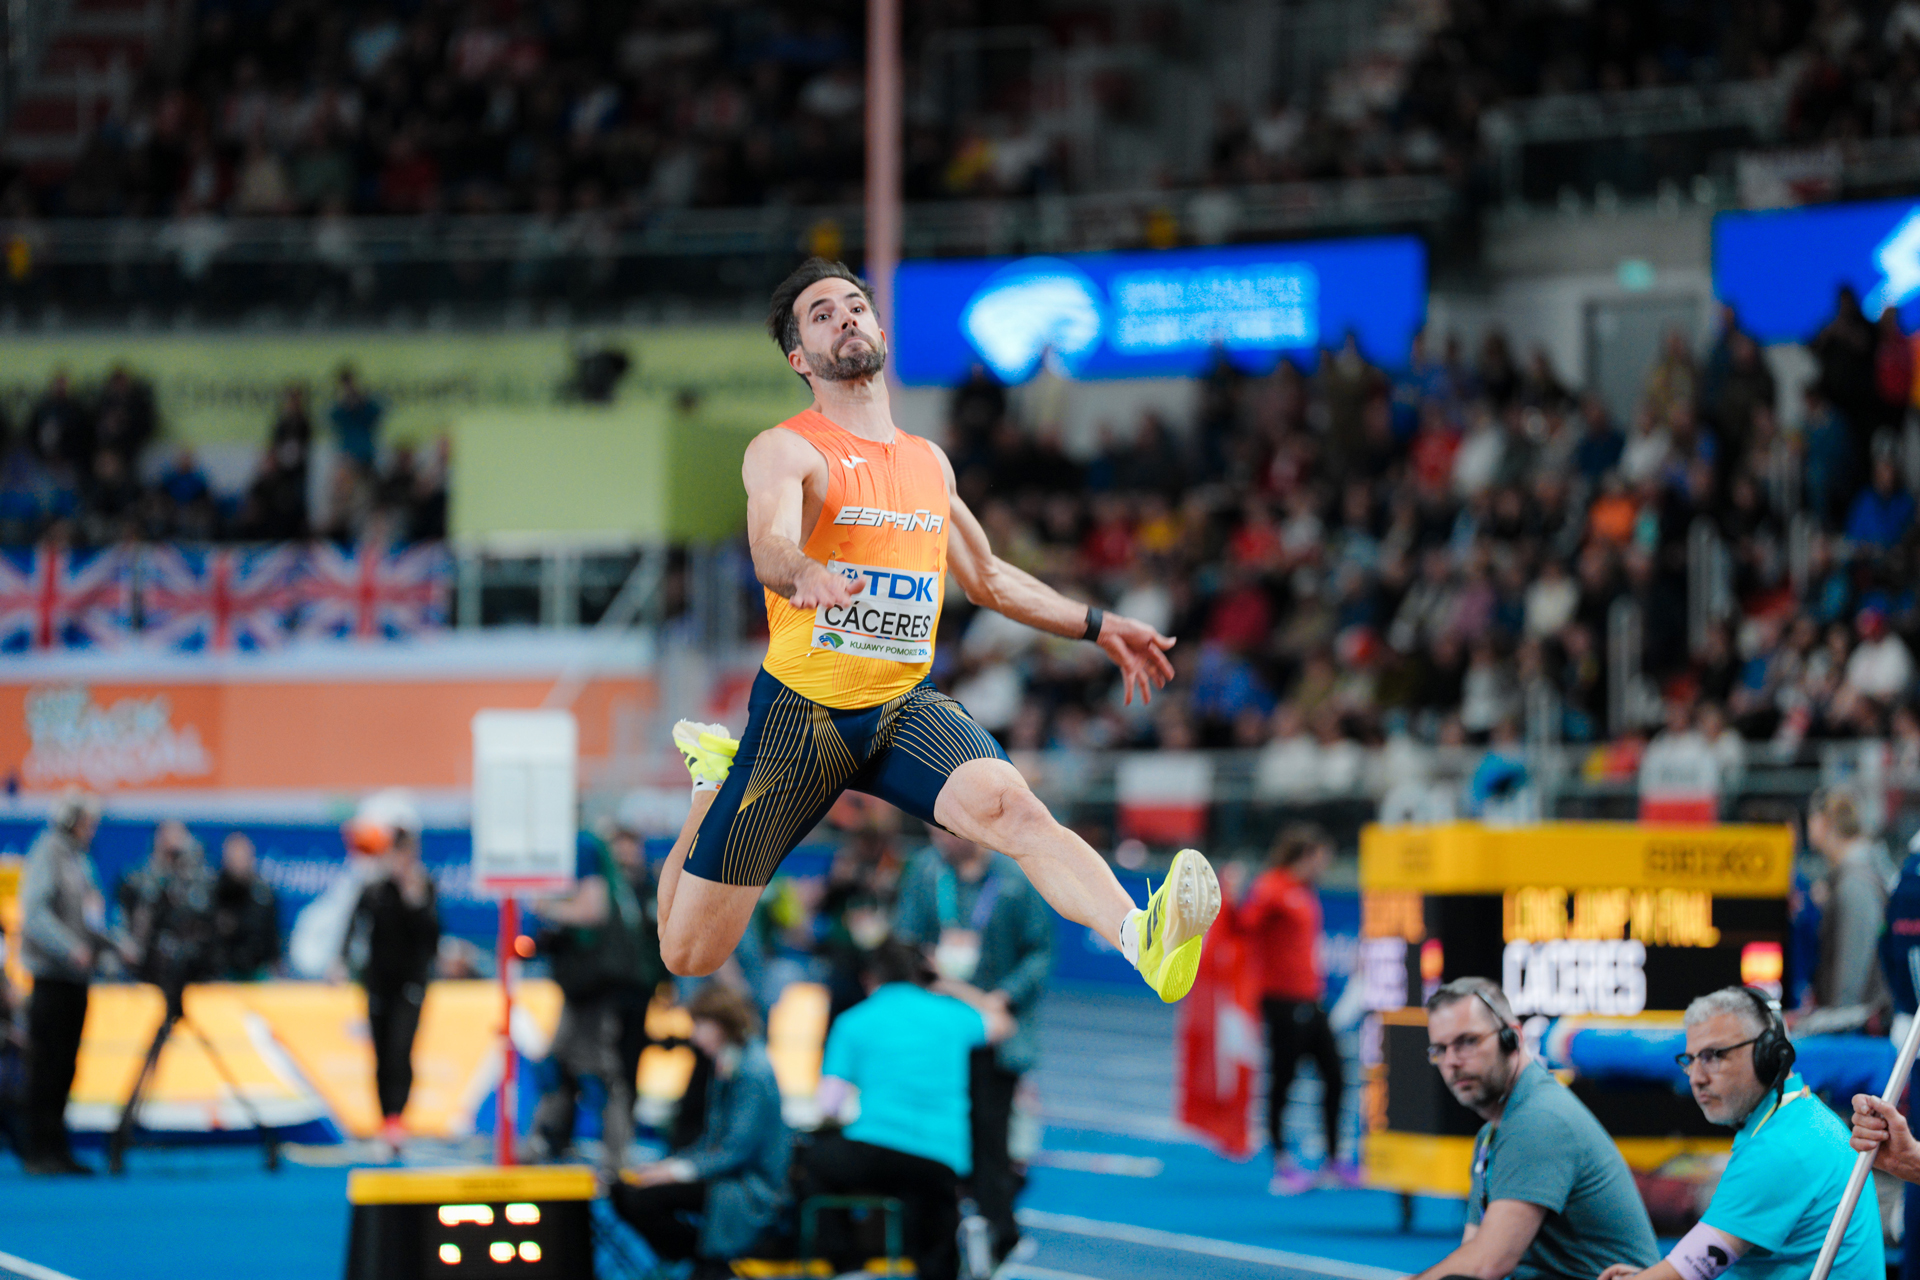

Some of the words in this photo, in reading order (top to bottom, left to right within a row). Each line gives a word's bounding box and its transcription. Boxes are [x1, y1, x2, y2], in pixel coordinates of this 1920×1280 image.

[833, 505, 944, 534] ESPAÑA
[862, 570, 934, 602] TDK
[824, 600, 931, 638] CÁCERES
[849, 640, 885, 653] KUJAWY
